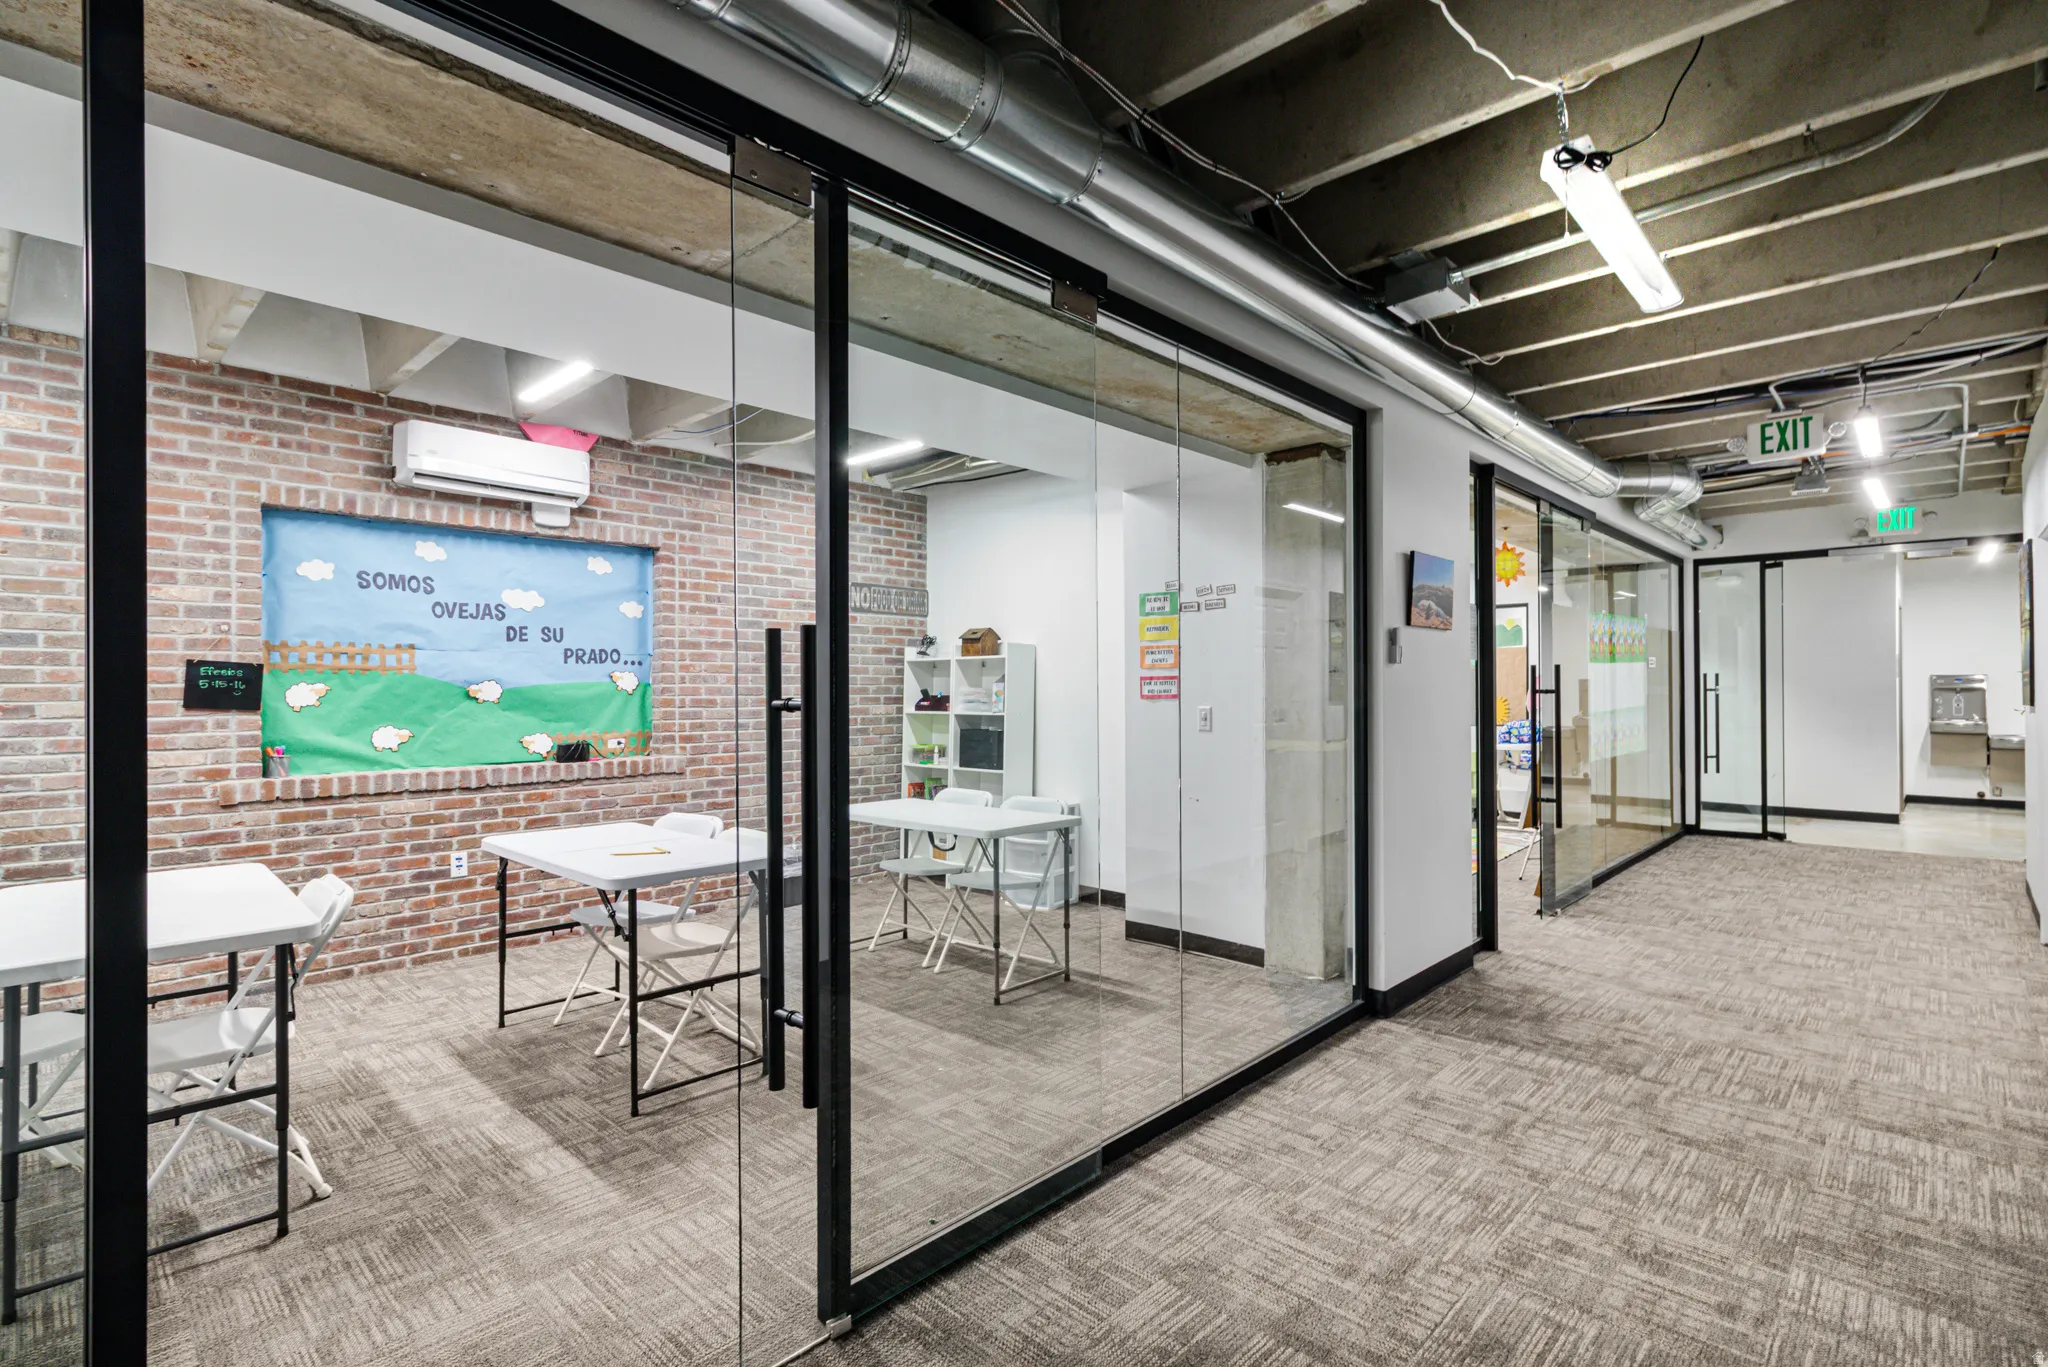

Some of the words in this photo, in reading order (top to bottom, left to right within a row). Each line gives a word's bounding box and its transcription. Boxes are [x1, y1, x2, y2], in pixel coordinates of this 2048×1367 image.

[1760, 415, 1813, 455] EXIT
[1876, 506, 1917, 533] EXIT
[356, 569, 435, 596] SOMOS
[851, 586, 870, 609] NO
[872, 588, 892, 610] FOOD
[894, 590, 904, 610] OR
[431, 600, 507, 622] OVEJAS
[506, 625, 529, 643] DE
[541, 625, 565, 644] SU
[563, 647, 643, 667] PRADO...
[199, 666, 244, 677] Efesios
